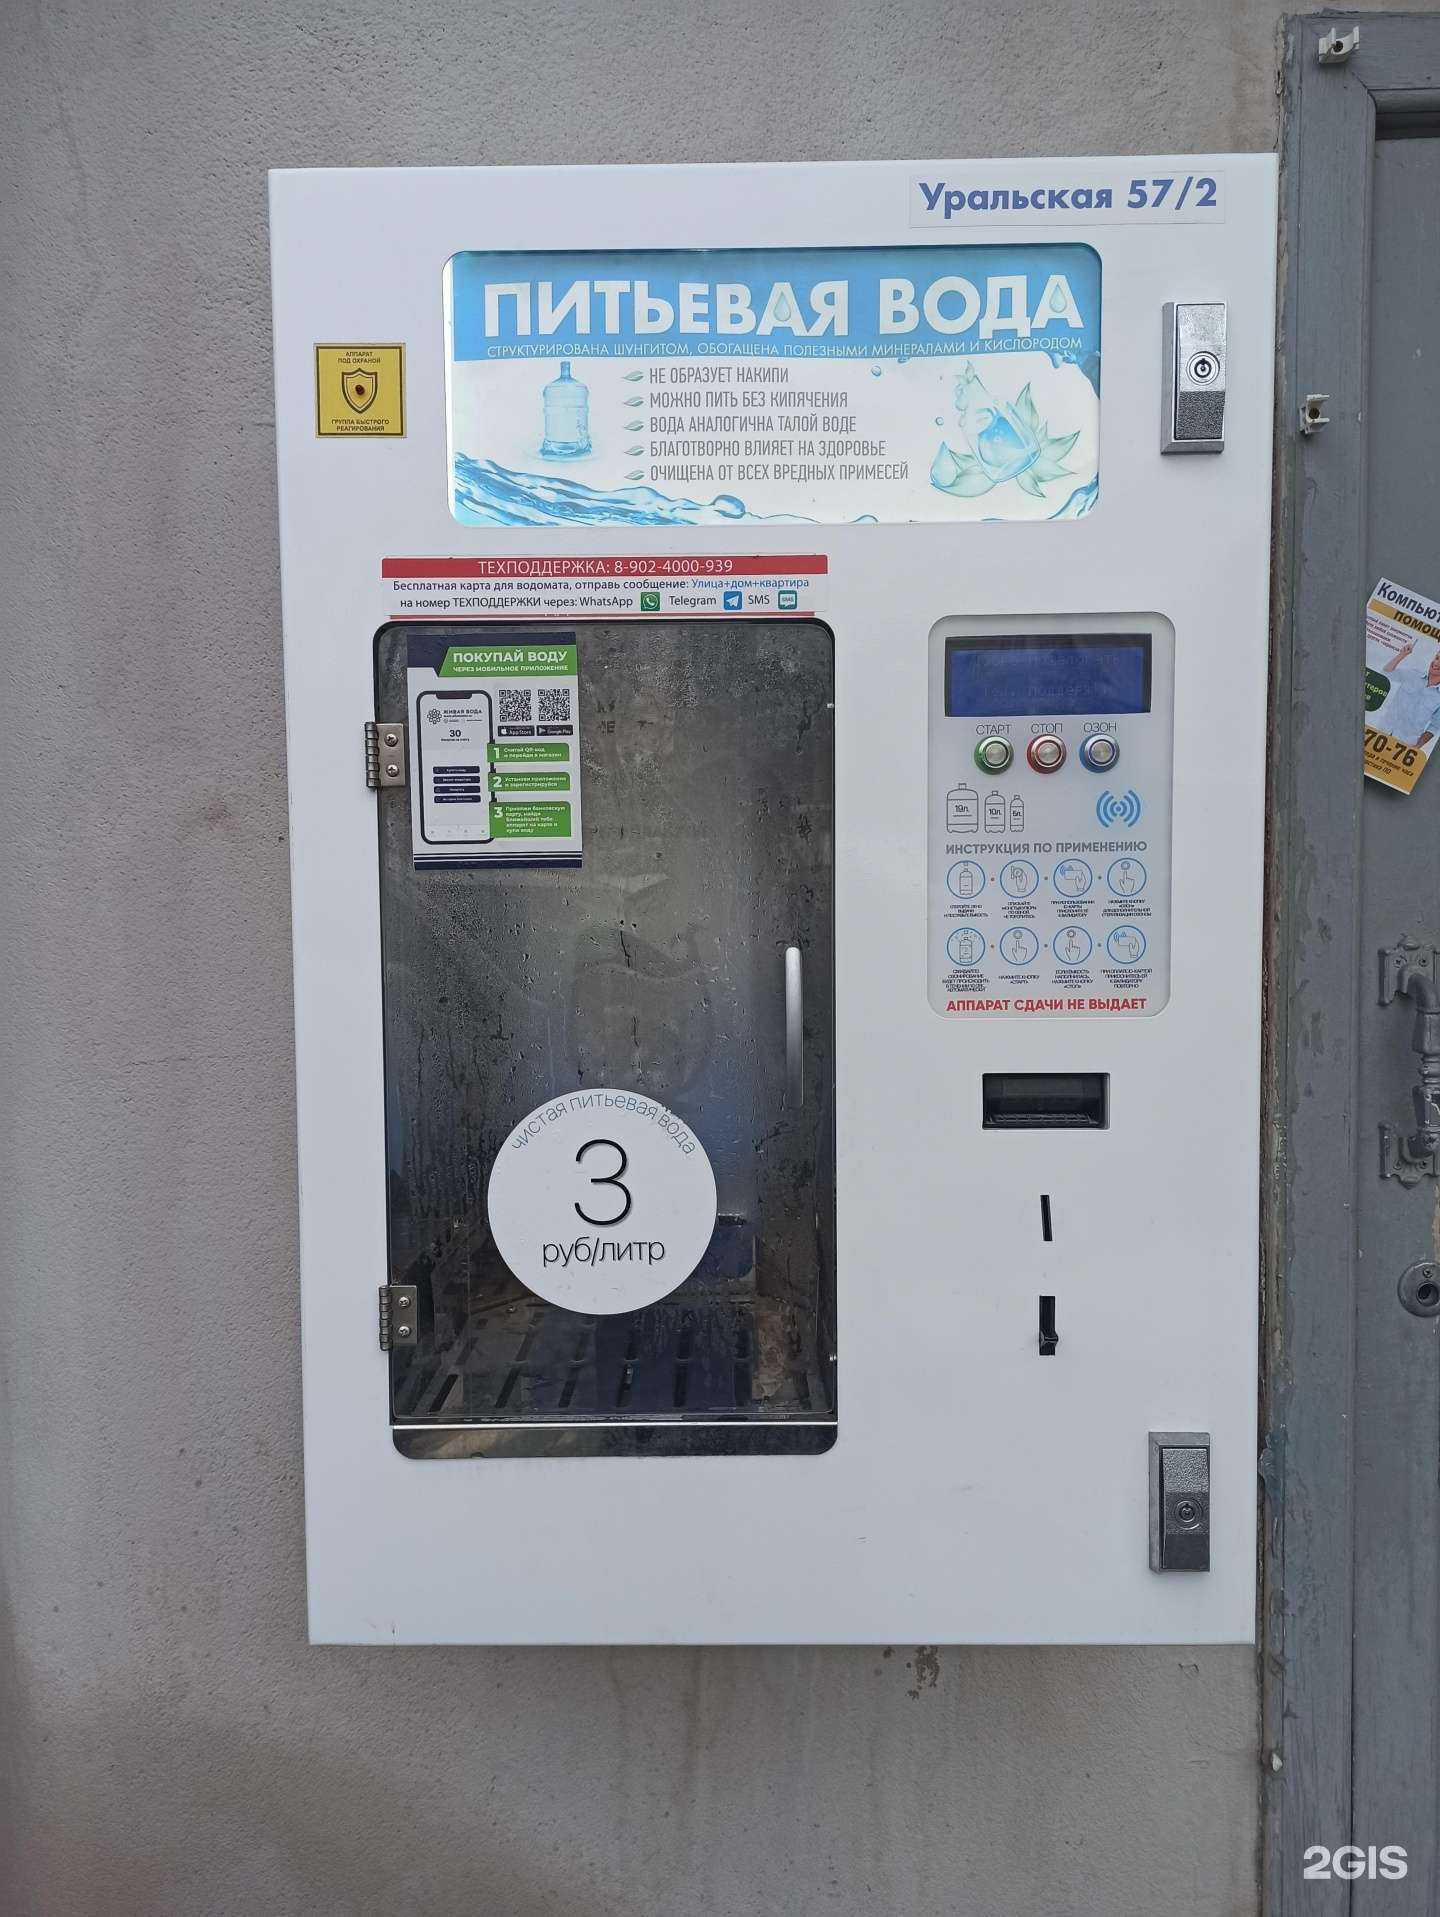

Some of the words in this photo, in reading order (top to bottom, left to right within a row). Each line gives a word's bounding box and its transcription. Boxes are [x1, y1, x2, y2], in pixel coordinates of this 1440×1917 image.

[918, 182, 1113, 219] Уральская
[1126, 176, 1218, 210] 57/2
[484, 281, 848, 337] ПИТЬЕВАЯ
[880, 274, 1084, 338] ВОДА
[487, 343, 609, 357] СТРУКТУРИРОВАНА
[614, 342, 693, 357] ШУНГИТОМ,
[697, 342, 780, 356] ОБОГАЩЕНА
[784, 343, 868, 357] ПОЛЕЗНЫМИ
[872, 341, 966, 356] МИНЕРАЛАМИ
[971, 339, 981, 351] И
[985, 336, 1083, 351] КИСЛОРОДОМ
[650, 367, 666, 384] НЕ
[670, 366, 733, 384] ОБРАЗУЕТ
[736, 366, 789, 383] НАКИПИ
[650, 391, 701, 408] МОЖНО
[705, 391, 738, 408] ПИТЬ
[742, 391, 766, 408] БЕЗ
[770, 391, 848, 408] КИПЯЧЕНИЯ
[650, 416, 685, 435] ВОДА
[689, 415, 774, 433] АНАЛОГИЧНА
[777, 413, 820, 433] ТАЛОЙ
[823, 415, 857, 434] ВОДЕ
[650, 440, 740, 457] БЛАГОТВОРНО
[744, 440, 795, 457] ВЛИЯЕТ
[798, 440, 815, 456] НА
[818, 439, 886, 458] ЗДОРОВЬЕ
[650, 464, 714, 483] ОЧИЩЕНА
[717, 464, 735, 481] ОТ
[738, 464, 770, 480] ВСЕХ
[774, 463, 835, 482] ВРЕДНЫХ
[839, 460, 909, 480] ПРИМЕСЕЙ
[478, 560, 610, 576] ТЕХПОДДЕРЖКА:
[614, 559, 733, 573] 8-902-4000-939
[393, 580, 457, 591] Бесплатная
[460, 581, 491, 592] карта
[494, 582, 514, 591] для
[517, 580, 573, 591] водомата,
[575, 580, 620, 592] отправь
[623, 579, 690, 591] сообщение:
[691, 578, 809, 590] Улица+дом+квартира
[400, 600, 413, 608] на
[416, 599, 451, 610] номер
[452, 597, 541, 609] ТЕХПОДДЕРЖКИ
[544, 598, 578, 608] через:
[579, 595, 634, 608] WhatsApp
[669, 595, 717, 607] Telegram
[748, 594, 770, 605] SMS
[453, 649, 524, 663] ПОКУПАЙ
[528, 651, 568, 664] ВОДУ
[449, 729, 462, 737] 30
[975, 724, 1011, 735] СТАРТ
[1030, 723, 1063, 734] СТОП
[1083, 722, 1117, 733] ОЗОН
[494, 747, 500, 759] 1
[493, 776, 503, 788] 2
[494, 806, 503, 818] 3
[946, 843, 1030, 855] ИНСТРУКЦИЯ
[1033, 843, 1053, 853] ПО
[1056, 841, 1148, 853] ПРИМЕНЕНИЮ
[947, 999, 1011, 1011] АППАРАТ
[1014, 999, 1063, 1012] СДАЧИ
[1067, 998, 1087, 1010] НЕ
[1089, 998, 1147, 1011] ВЫДАЕТ
[512, 1103, 567, 1150] чистая
[569, 1094, 658, 1120] питьевая
[657, 1111, 697, 1155] вода
[574, 1138, 633, 1227] 3
[542, 1236, 666, 1268] руб/литр
